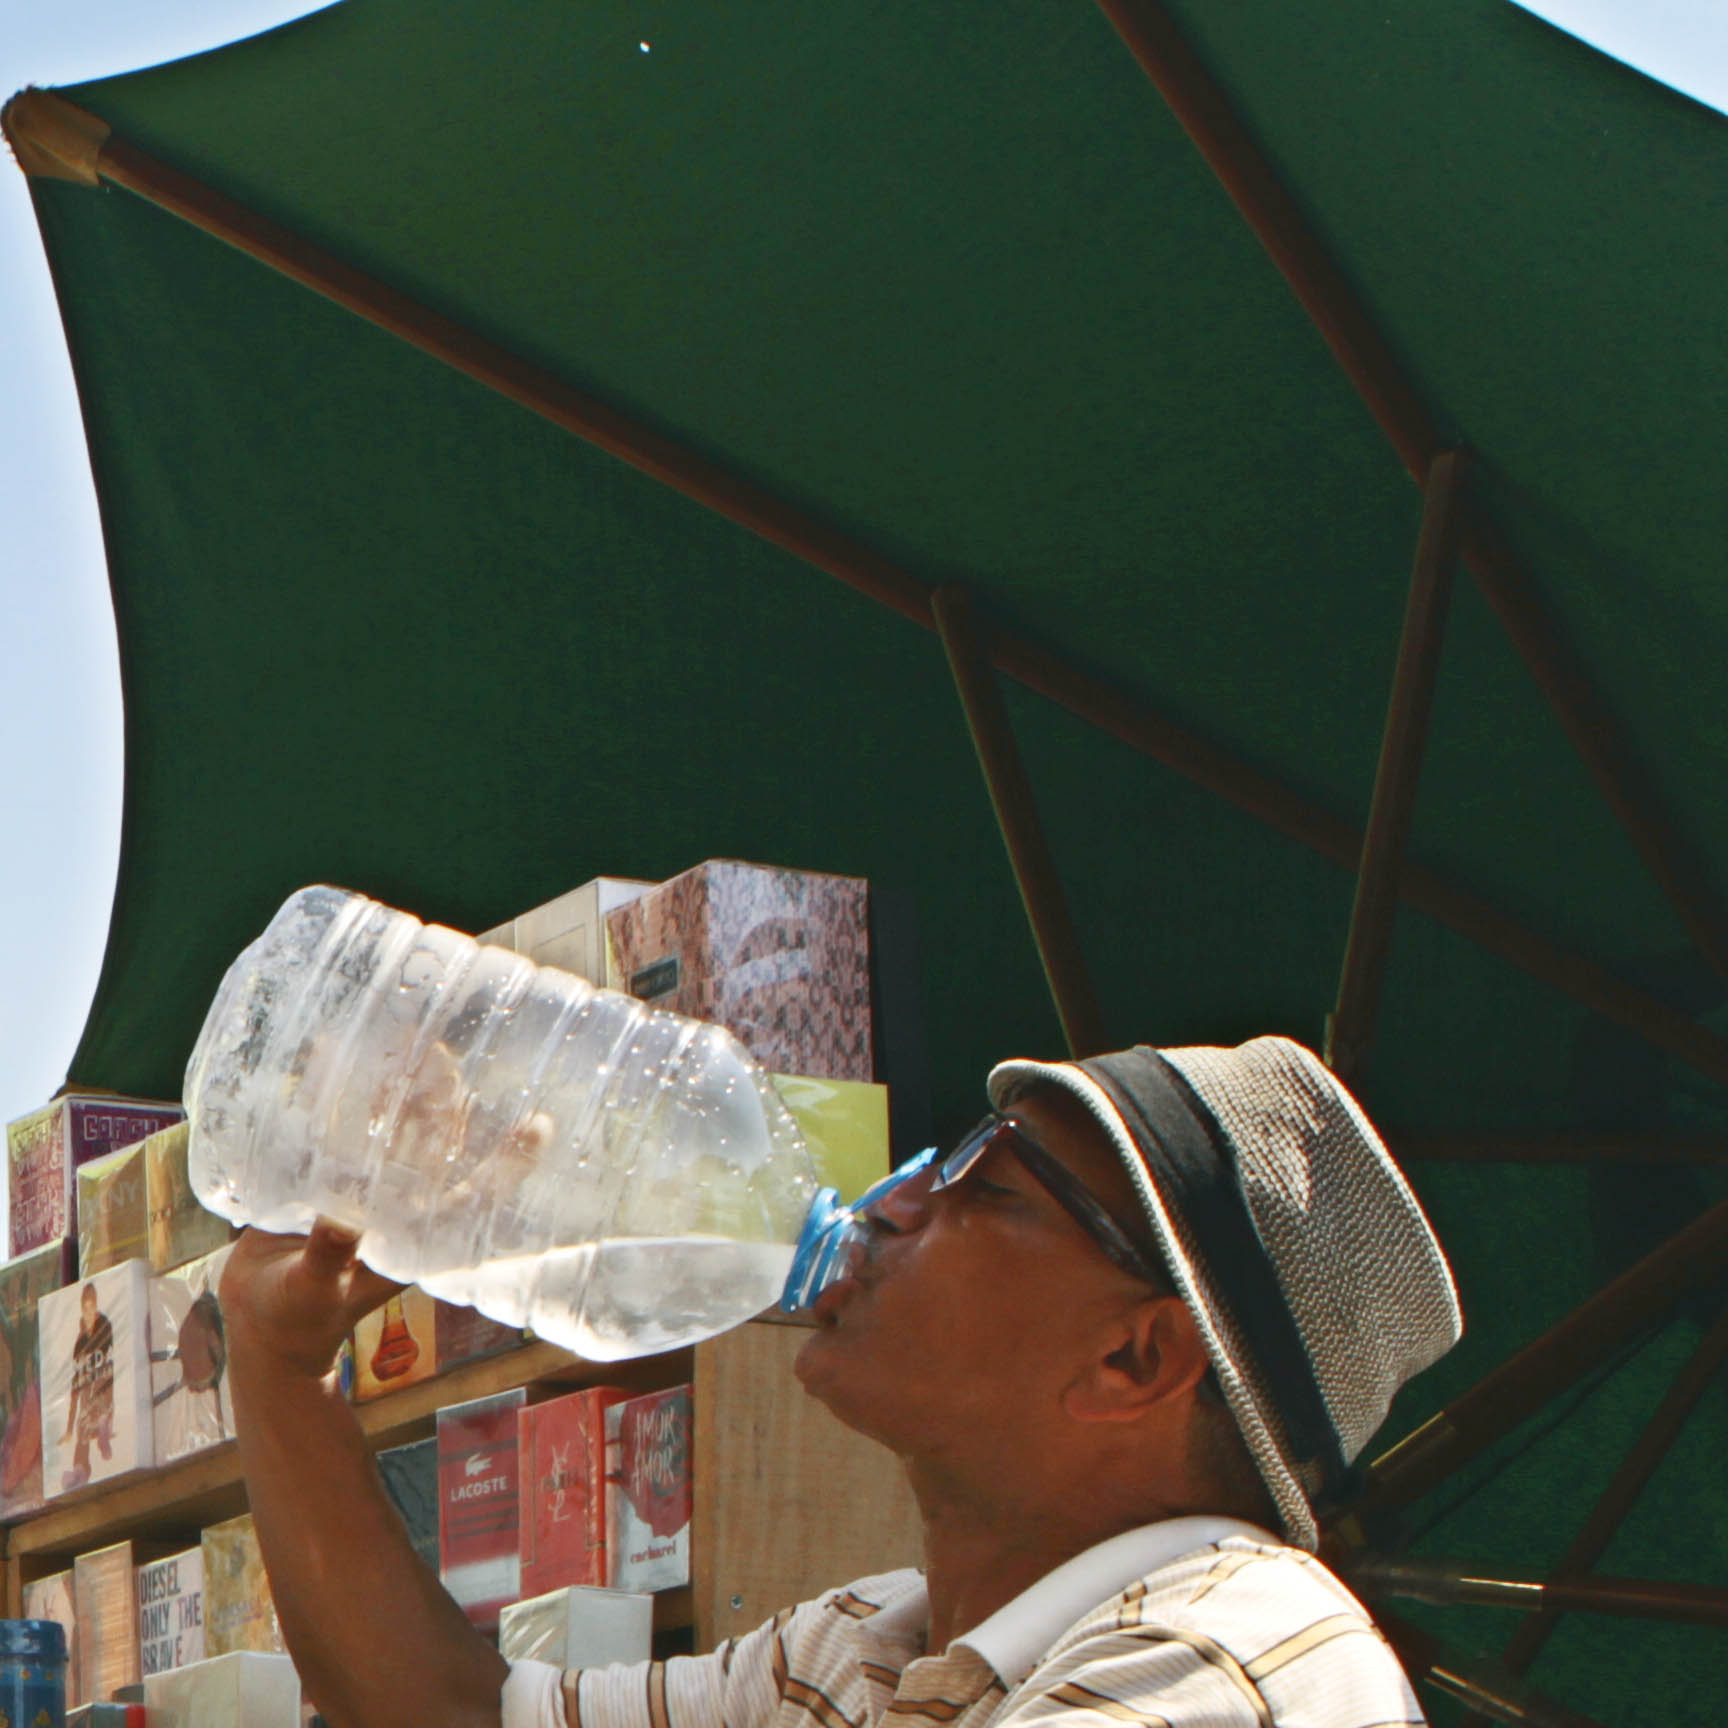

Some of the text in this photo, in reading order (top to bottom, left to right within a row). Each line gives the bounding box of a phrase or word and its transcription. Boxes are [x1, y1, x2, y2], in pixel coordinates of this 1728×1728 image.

[450, 1476, 508, 1502] LACOSTE
[140, 1560, 182, 1605] DIESEL
[141, 1602, 171, 1641] ONLY
[176, 1592, 203, 1632] THE
